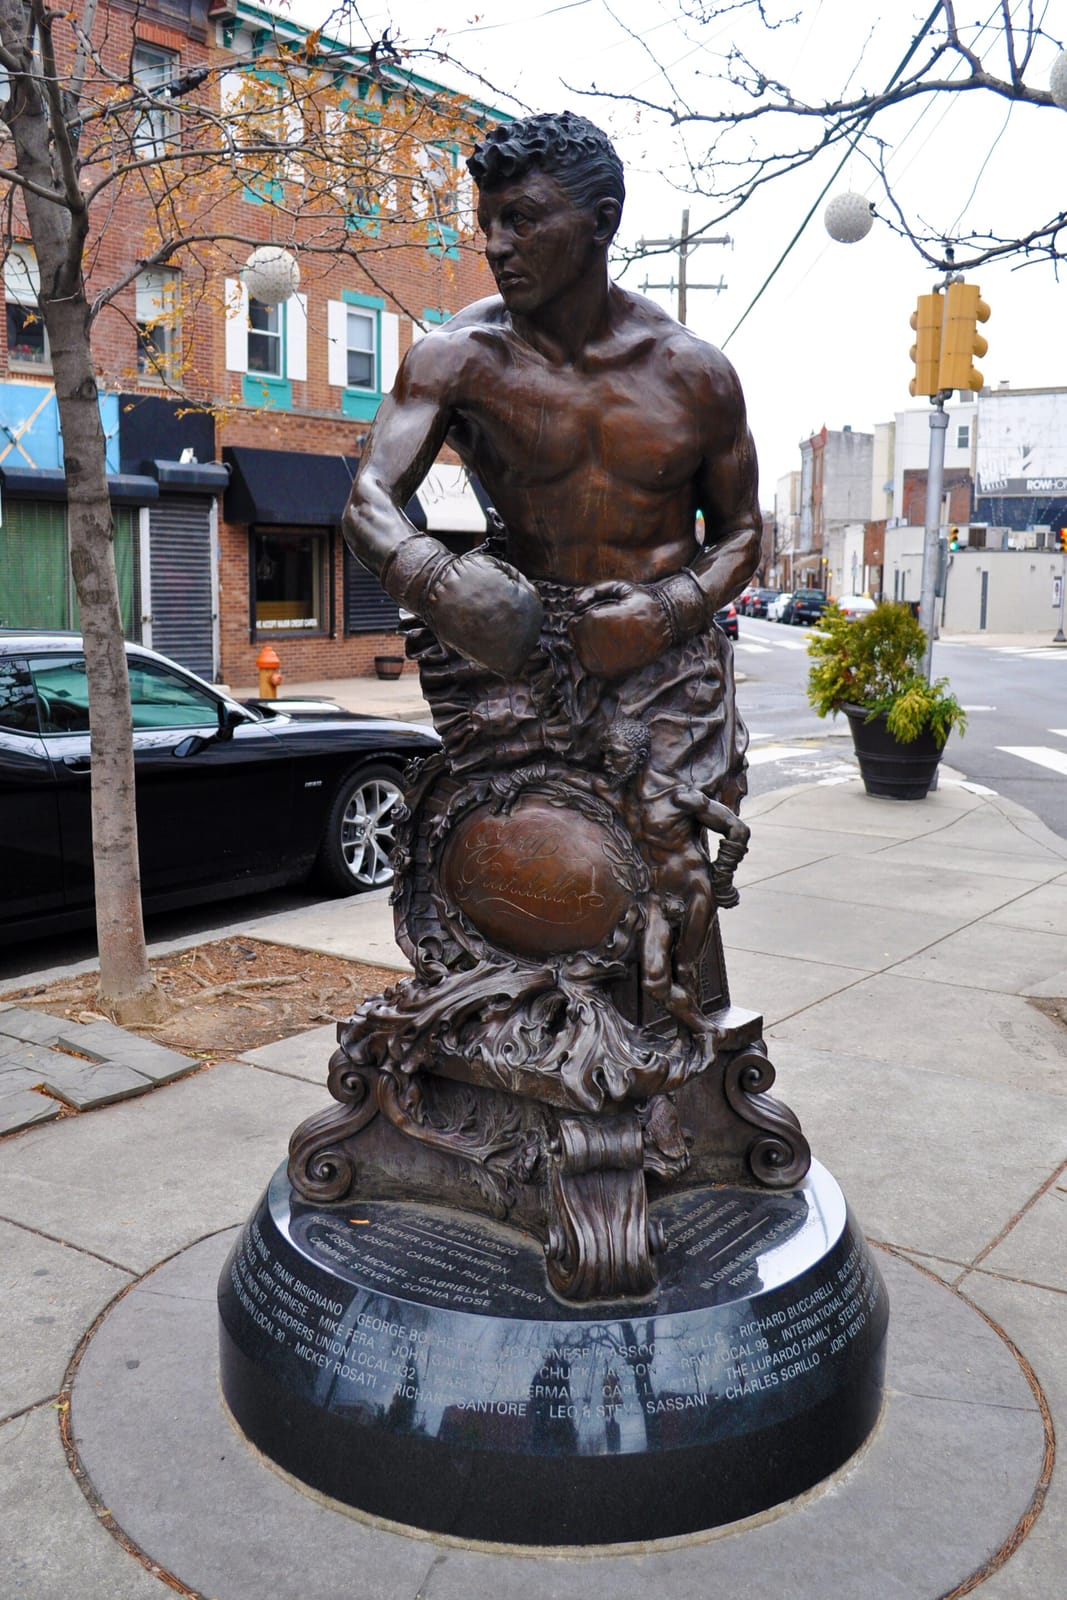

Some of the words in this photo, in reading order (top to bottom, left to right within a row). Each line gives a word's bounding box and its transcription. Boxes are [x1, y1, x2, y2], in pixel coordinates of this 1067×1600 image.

[443, 1228, 475, 1242] JEAN
[474, 1238, 519, 1256] MONZO
[663, 1220, 688, 1240] OVING
[685, 1199, 718, 1222] MEMORY
[676, 1228, 696, 1243] DEEP
[694, 1199, 740, 1230] ADMIRATION
[685, 1226, 729, 1256] BISIGNANO
[726, 1209, 752, 1231] FAMILY
[325, 1232, 359, 1254] JOSEPH
[361, 1254, 408, 1277] MICHAEL
[418, 1275, 490, 1297] GABRIELLA
[371, 1222, 421, 1242] FOREVER
[421, 1240, 447, 1253] OUR
[447, 1248, 511, 1275] CHAMPION
[700, 1279, 713, 1290] IN
[710, 1260, 740, 1283] LOVING
[735, 1235, 769, 1264] MEMORY
[765, 1228, 779, 1241] OF
[775, 1217, 795, 1233] MOM
[272, 1261, 296, 1288] FRANK
[293, 1280, 343, 1317] BISIGNANO
[356, 1312, 406, 1338] GEORGE
[740, 1310, 787, 1338] RICHARD
[786, 1281, 834, 1320] BUCCARELLI
[350, 1262, 396, 1284] STEVEN
[401, 1281, 449, 1299] SOPHIA
[453, 1294, 493, 1307] ROSE
[406, 1250, 456, 1272] CARMAN
[461, 1269, 490, 1285] PAUL
[498, 1282, 547, 1304] STEVEN
[728, 1266, 751, 1288] FROM
[257, 1266, 277, 1291] LARRY
[273, 1285, 309, 1318] FARNESE
[318, 1315, 345, 1337] MIKE
[345, 1328, 375, 1349] FERA
[755, 1336, 769, 1353] 98
[781, 1295, 844, 1342] INTERNATIONAL
[257, 1290, 268, 1305] 57
[271, 1305, 315, 1341] LABORERS
[315, 1333, 350, 1357] UNION
[351, 1349, 389, 1373] LOCAL
[725, 1363, 750, 1381] THE
[801, 1323, 832, 1352] FAMILY
[838, 1297, 860, 1326] STEVEN
[253, 1309, 275, 1336] LOCAL
[274, 1328, 286, 1343] 30
[294, 1342, 333, 1369] MICKEY
[333, 1362, 377, 1389] ROSATI
[457, 1398, 527, 1417] SANTORE
[549, 1404, 578, 1419] LEO
[646, 1392, 708, 1414] SASSANI
[725, 1372, 779, 1400] CHARLES
[779, 1352, 821, 1382] SGRILLO
[829, 1332, 849, 1355] JOEY
[846, 1311, 867, 1339] VENTO
